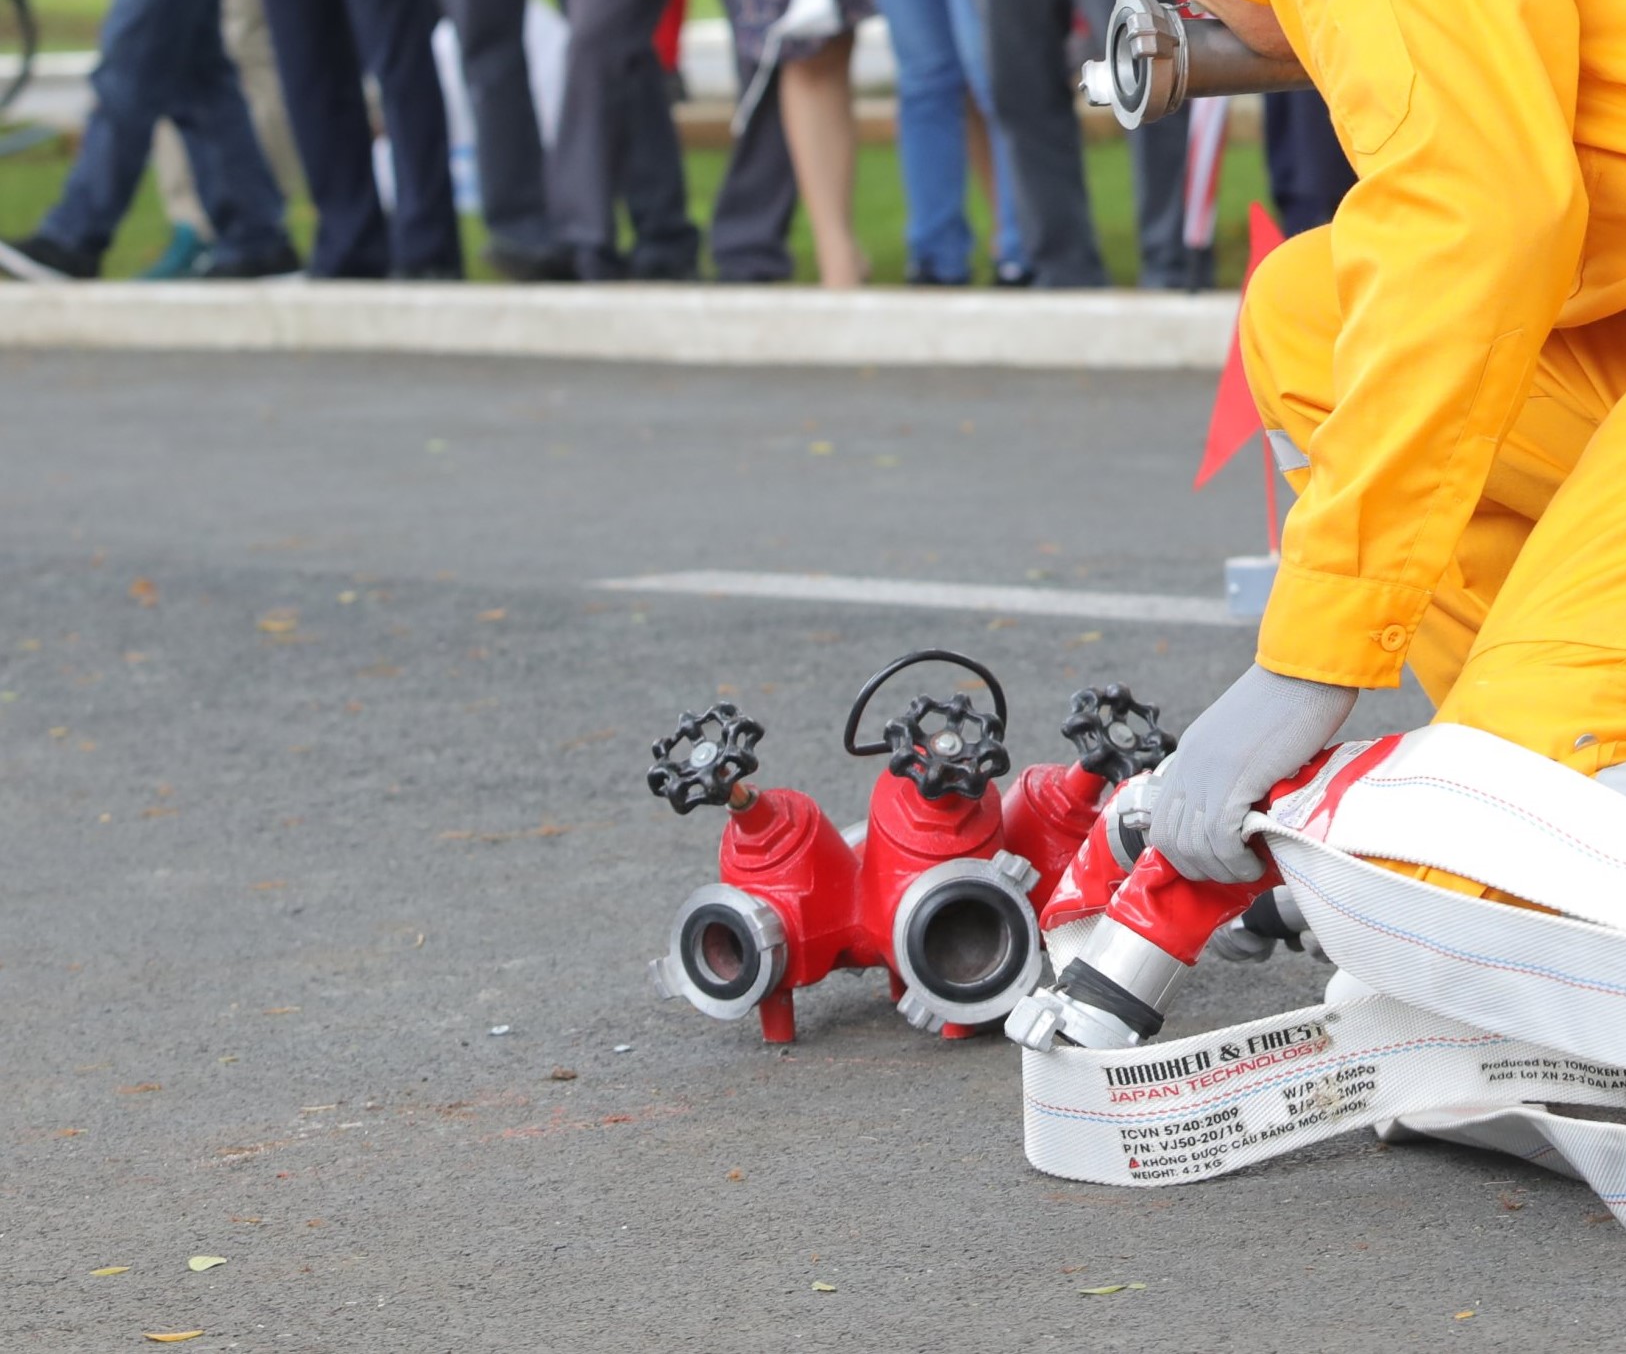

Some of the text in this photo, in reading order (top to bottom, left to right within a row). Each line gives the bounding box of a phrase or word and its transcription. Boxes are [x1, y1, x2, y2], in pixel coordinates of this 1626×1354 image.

[1220, 1043, 1242, 1063] &
[1111, 1039, 1328, 1104] JAPAN TECHNOLOGY
[1481, 1058, 1541, 1072] Produced
[1542, 1058, 1562, 1070] by:
[1563, 1060, 1620, 1077] TOMOKEN
[1488, 1069, 1517, 1082] Add:
[1520, 1069, 1538, 1079] Lot
[1541, 1070, 1559, 1080] XN
[1121, 1106, 1239, 1140] TCVN 5740:2009
[1123, 1121, 1244, 1155] P/N: VJ50-20/16
[1142, 1153, 1188, 1168] KHÔNG
[1182, 1163, 1201, 1175] 4.2
[1204, 1158, 1223, 1171] KG
